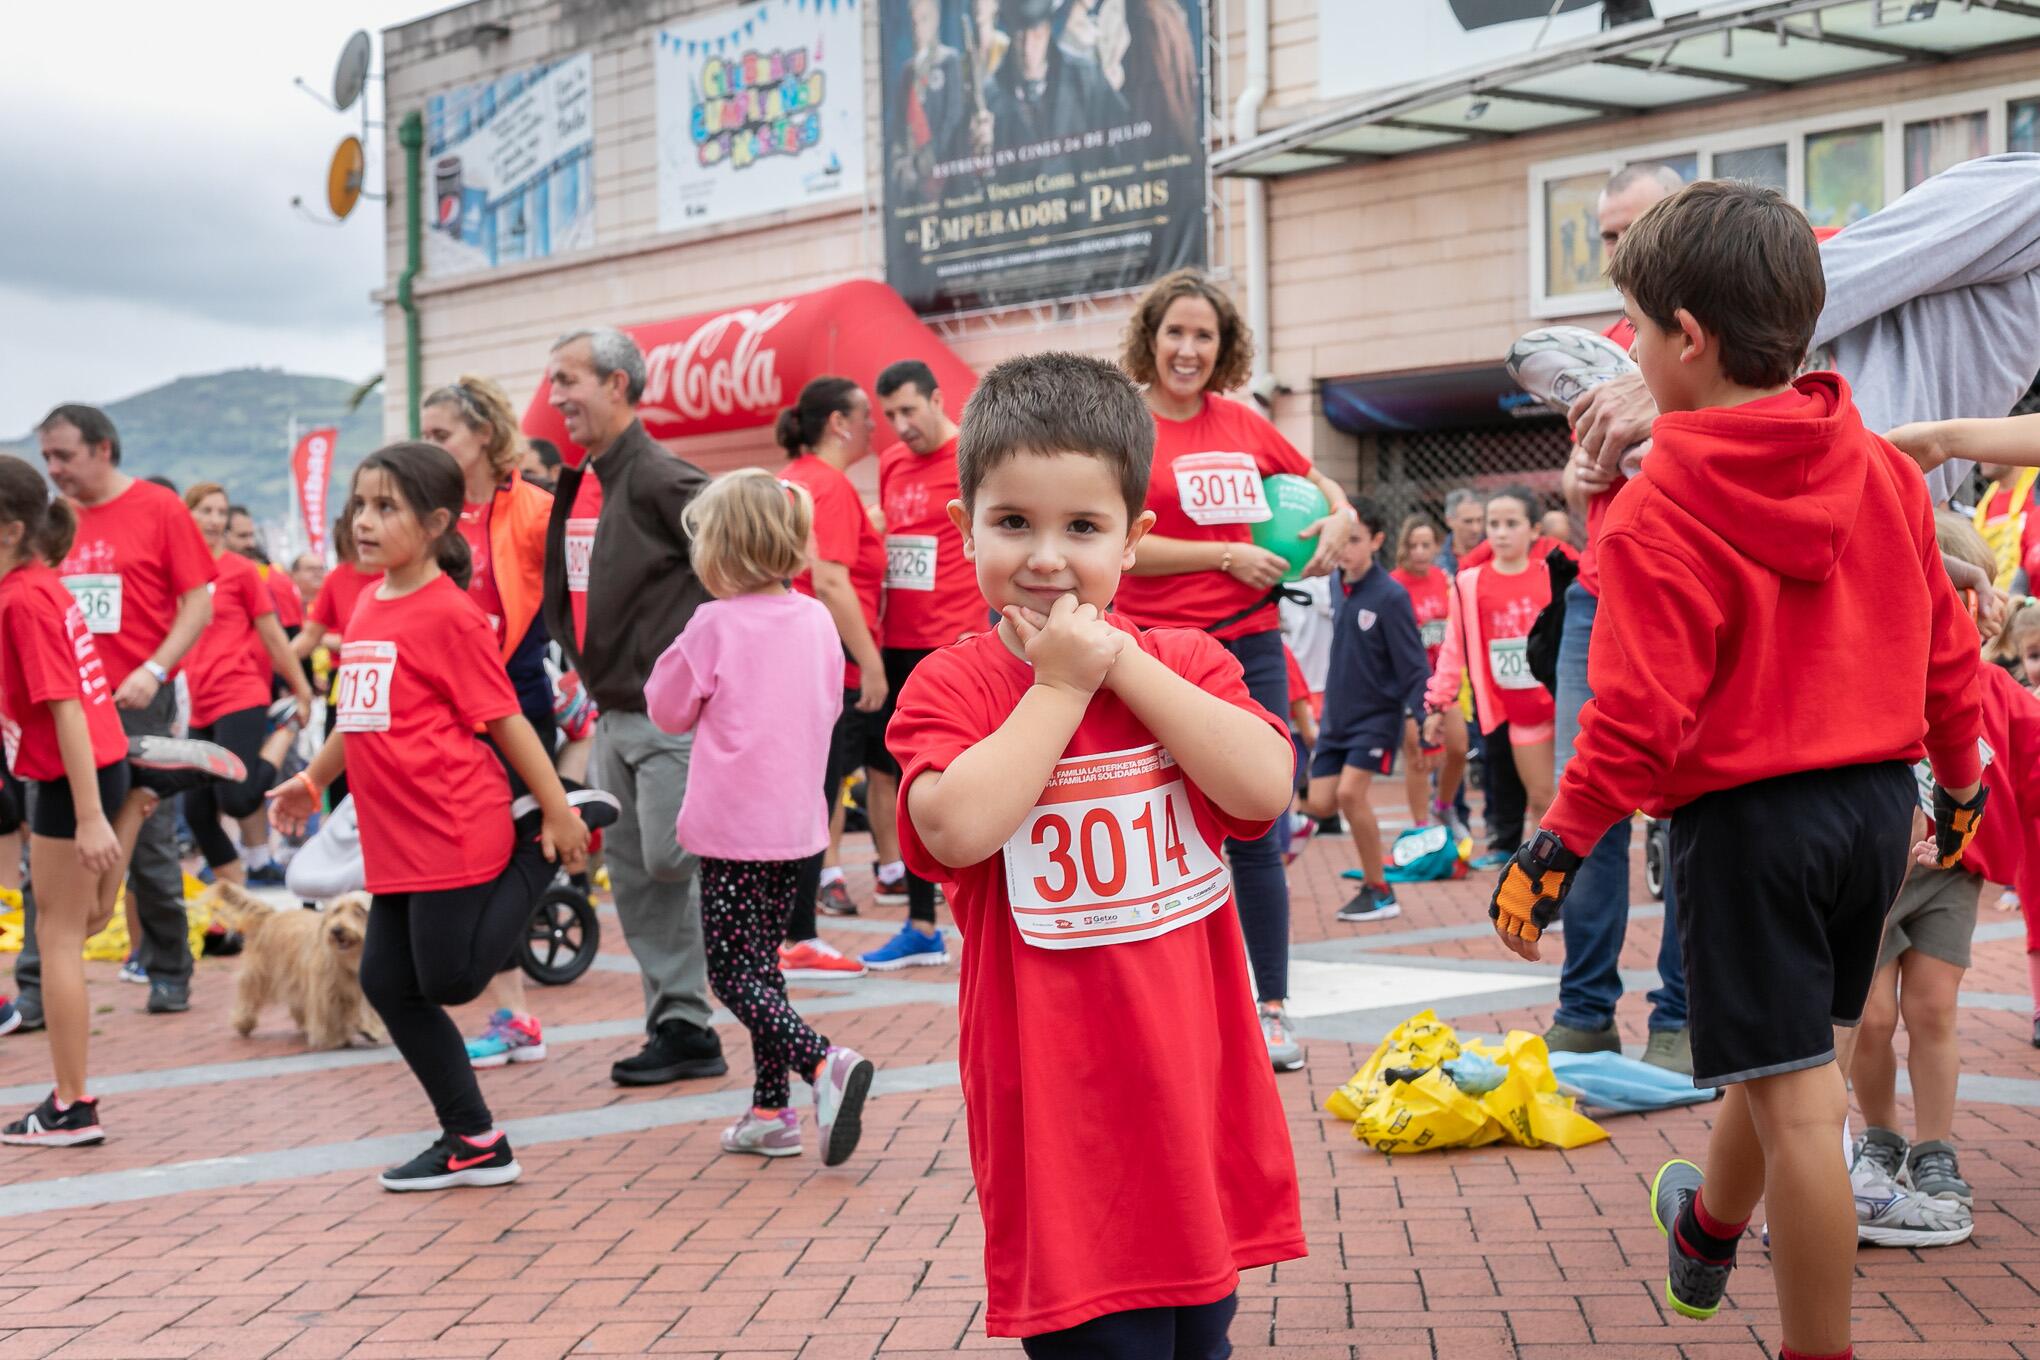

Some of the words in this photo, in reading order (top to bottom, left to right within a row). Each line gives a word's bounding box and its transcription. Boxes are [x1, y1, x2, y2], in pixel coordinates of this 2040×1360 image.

[920, 198, 1068, 251] EMPERADOR
[1090, 178, 1170, 222] PARIS
[1189, 474, 1257, 506] 3014
[80, 591, 111, 619] 36
[1497, 651, 1524, 677] 20
[1056, 767, 1088, 778] FAMILIA
[1058, 774, 1097, 786] FAMILIAR
[1097, 767, 1142, 780] SOLIDARIA
[1031, 793, 1191, 903] 3014
[1093, 913, 1118, 923] Getxo
